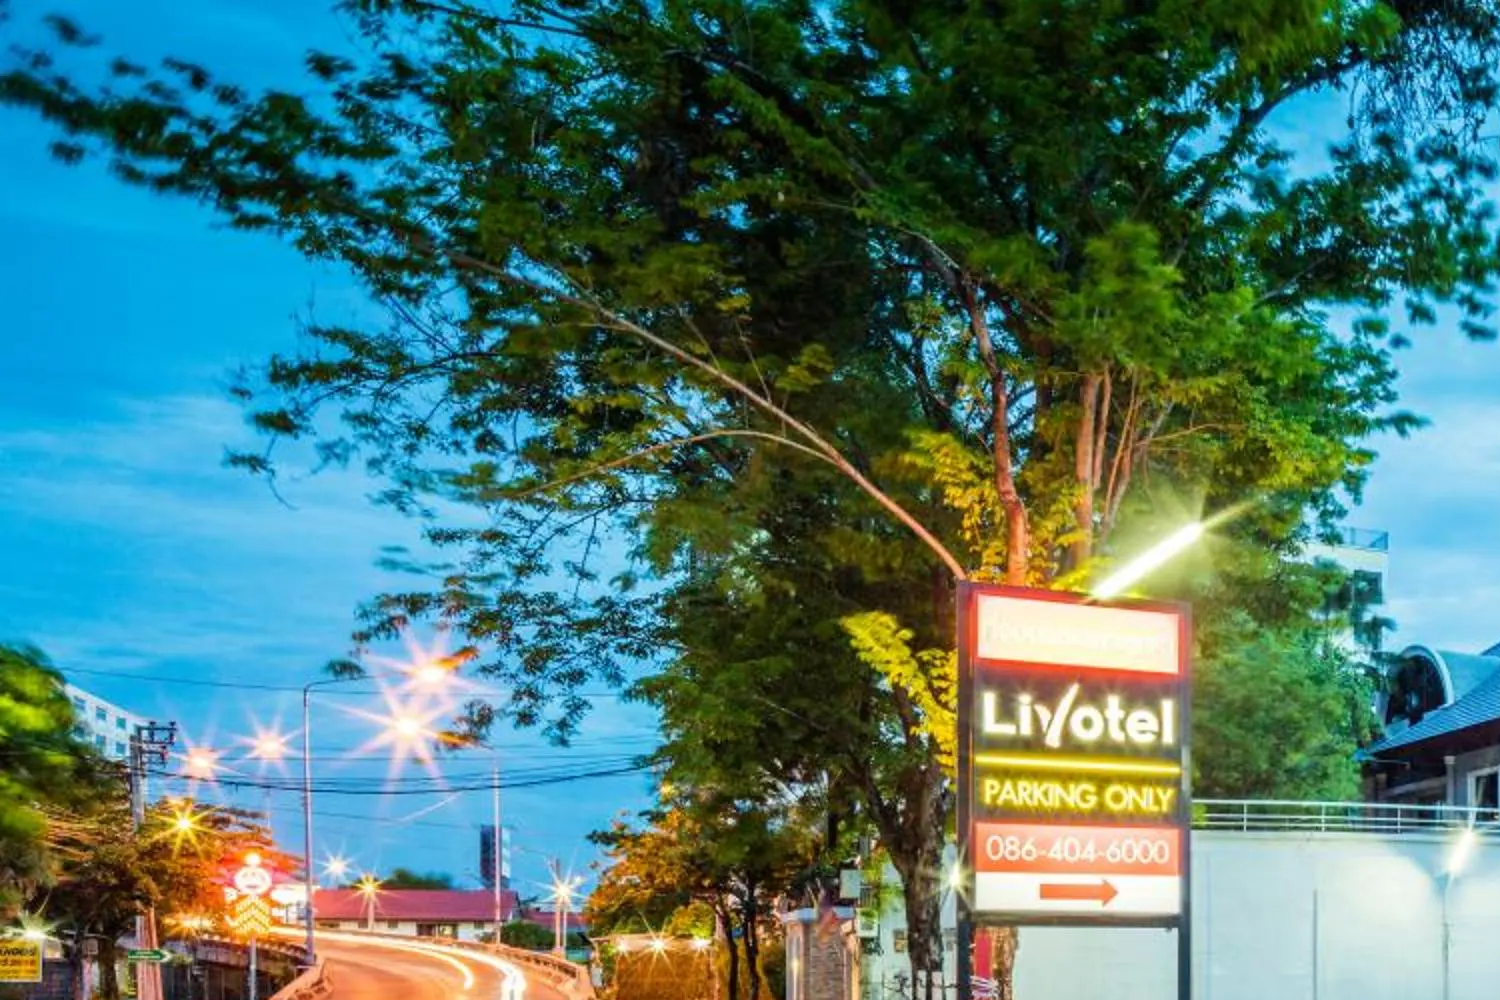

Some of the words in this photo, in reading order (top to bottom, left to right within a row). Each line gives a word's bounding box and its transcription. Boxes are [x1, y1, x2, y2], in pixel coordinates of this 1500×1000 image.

[981, 682, 1175, 748] Livotel
[984, 779, 1097, 810] PARKING
[1104, 784, 1175, 813] ONLY
[986, 835, 1170, 864] 086-404-6000
